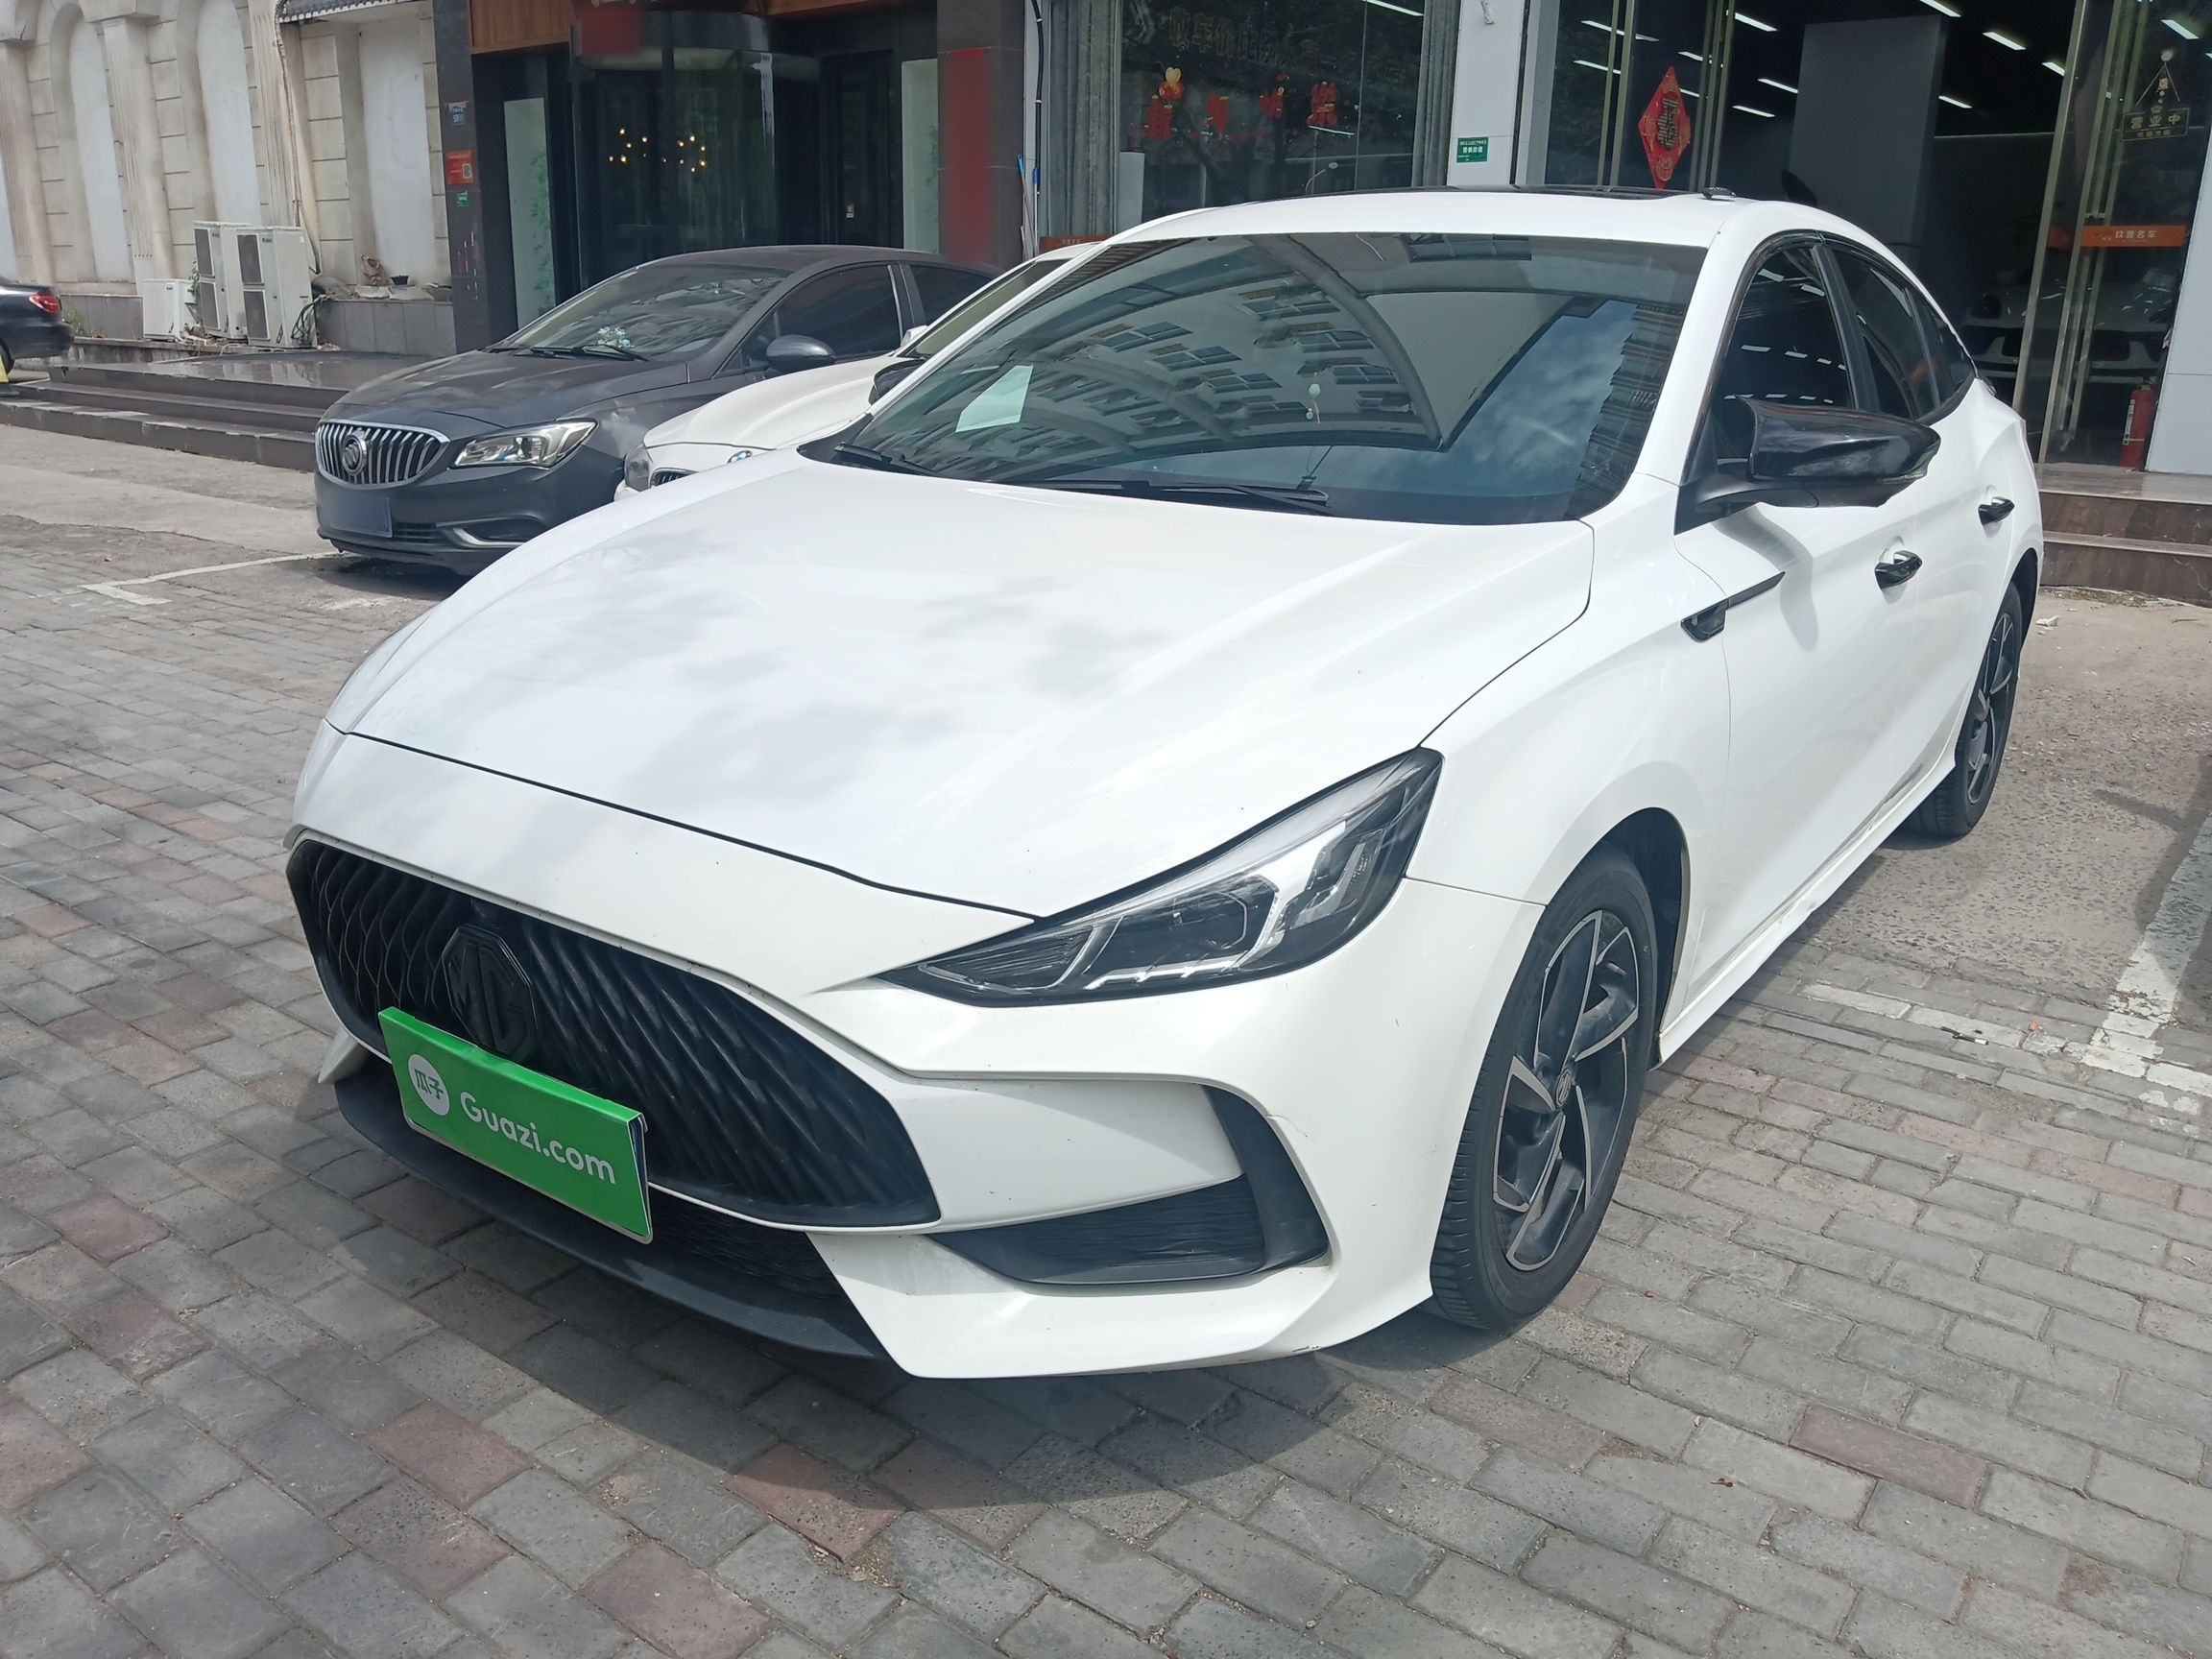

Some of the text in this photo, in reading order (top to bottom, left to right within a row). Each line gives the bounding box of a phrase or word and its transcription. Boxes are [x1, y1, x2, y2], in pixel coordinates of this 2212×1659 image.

[2130, 112, 2181, 131] 营业中
[447, 941, 530, 1057] MG
[414, 1068, 445, 1101] 瓜子
[460, 1091, 616, 1185] Guazi.com
